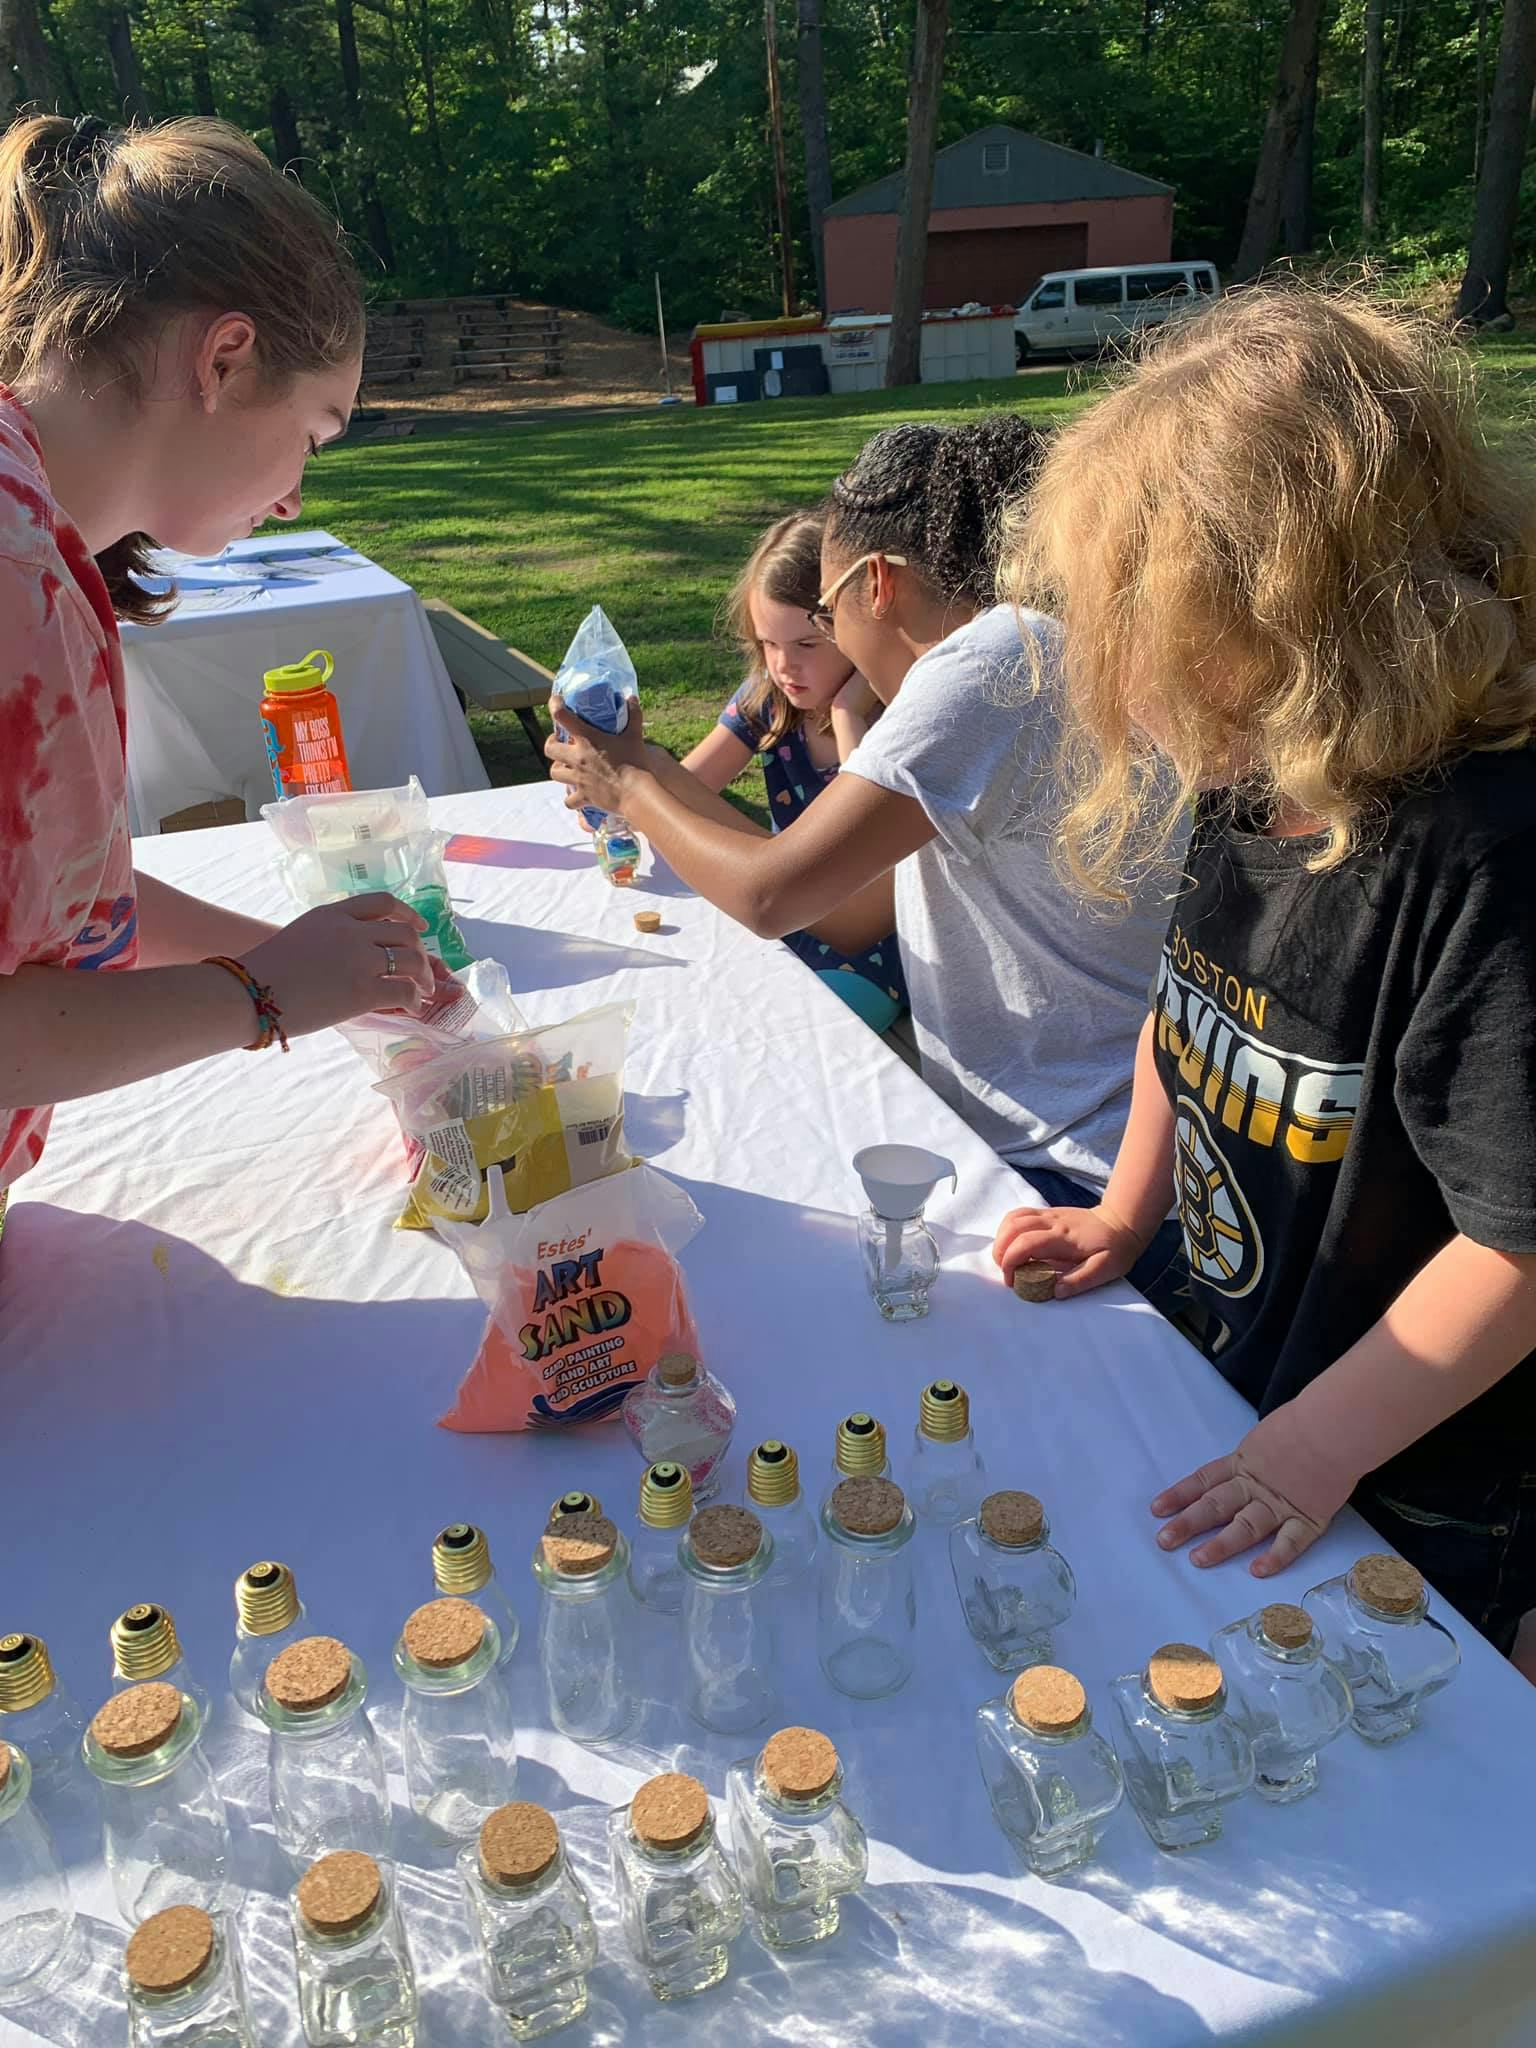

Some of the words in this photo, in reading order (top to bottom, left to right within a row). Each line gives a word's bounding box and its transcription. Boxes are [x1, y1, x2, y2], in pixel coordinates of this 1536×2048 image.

[294, 721, 308, 742] MY
[309, 717, 330, 740] BOSS
[297, 739, 328, 763] THINKS
[303, 760, 331, 784] PRETTY
[1156, 954, 1362, 1164] RUINS
[537, 1227, 592, 1260] Estes'
[532, 1248, 604, 1314] ART
[519, 1290, 632, 1362] SAND
[566, 1337, 624, 1365] PAINTING
[589, 1356, 611, 1373] ART
[571, 1361, 637, 1394] SCULPTURE
